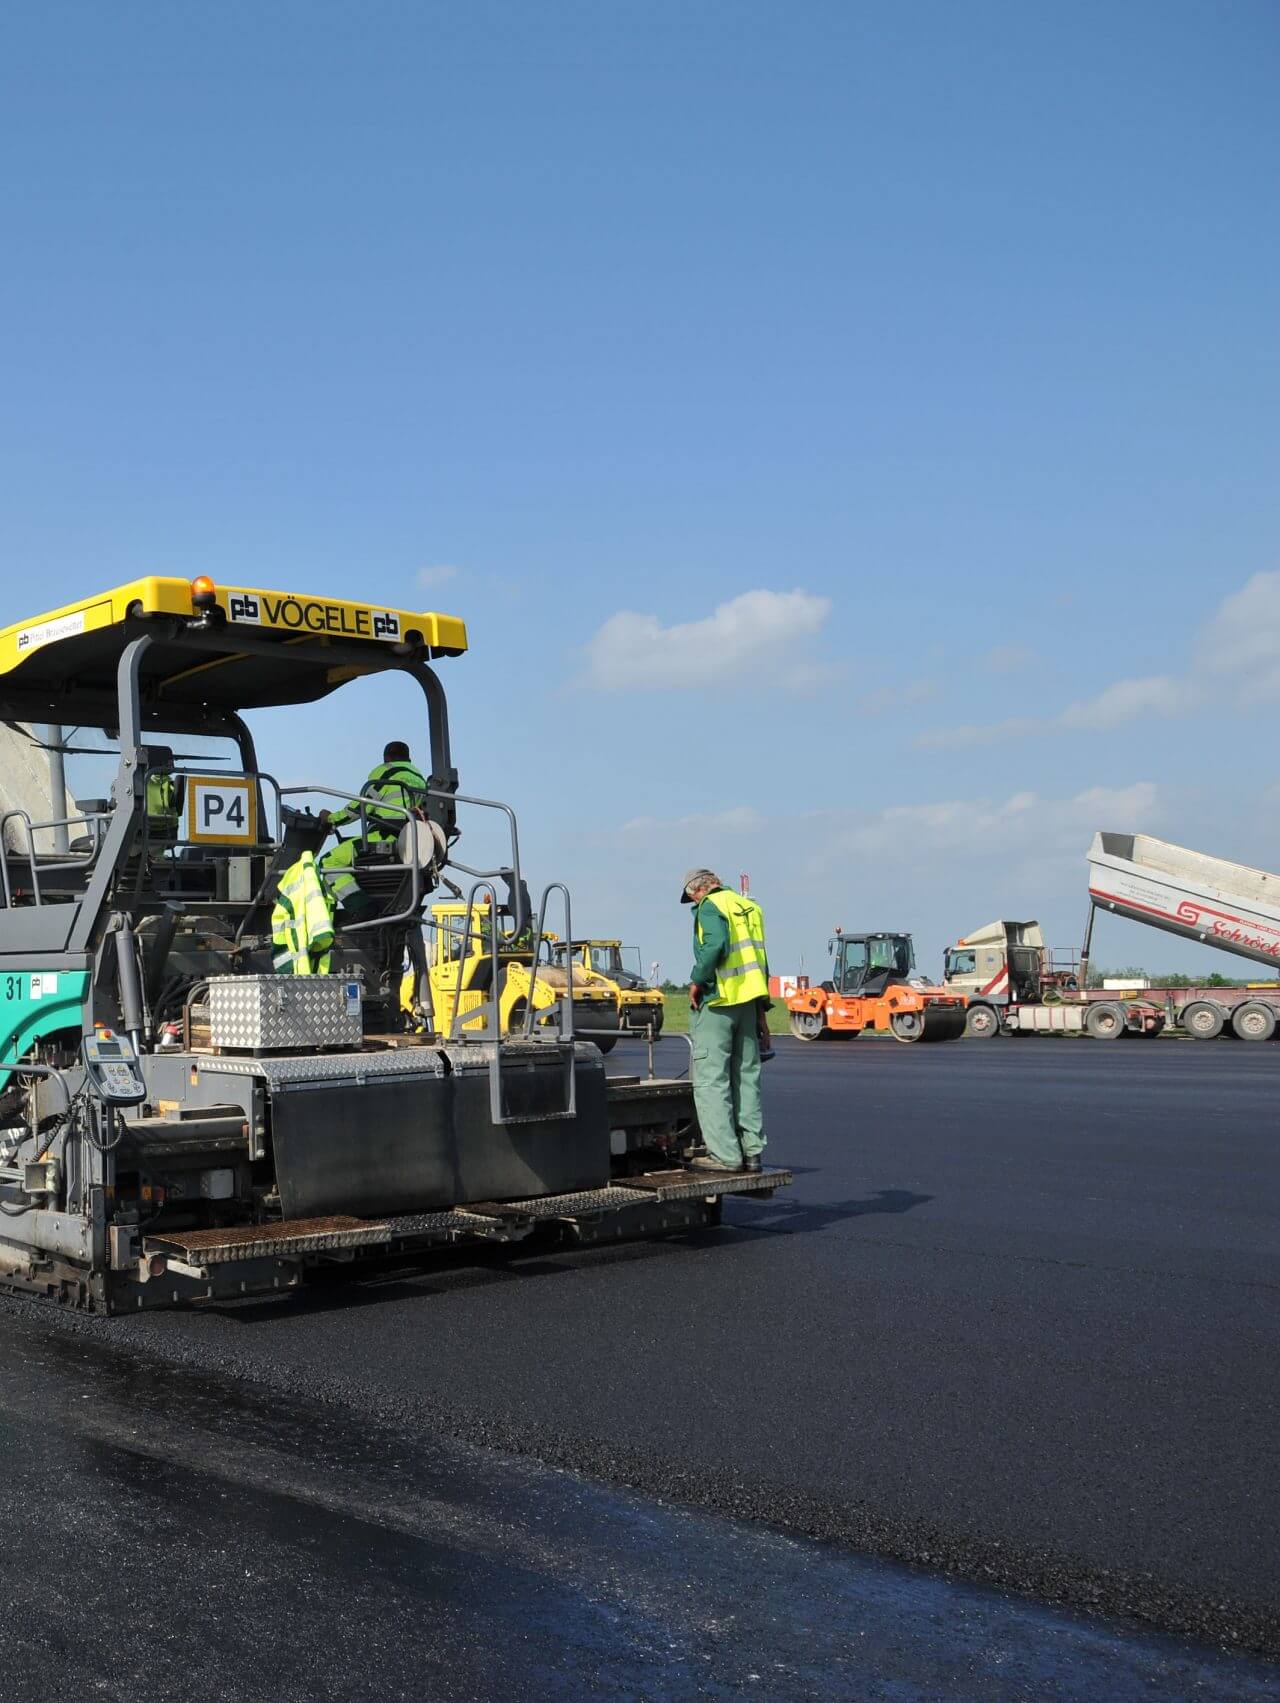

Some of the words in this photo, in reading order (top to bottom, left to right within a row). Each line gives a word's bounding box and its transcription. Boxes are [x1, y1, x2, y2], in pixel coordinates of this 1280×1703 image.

[262, 596, 370, 635] VÖGELE
[204, 794, 245, 829] P4
[6, 976, 22, 1001] 31
